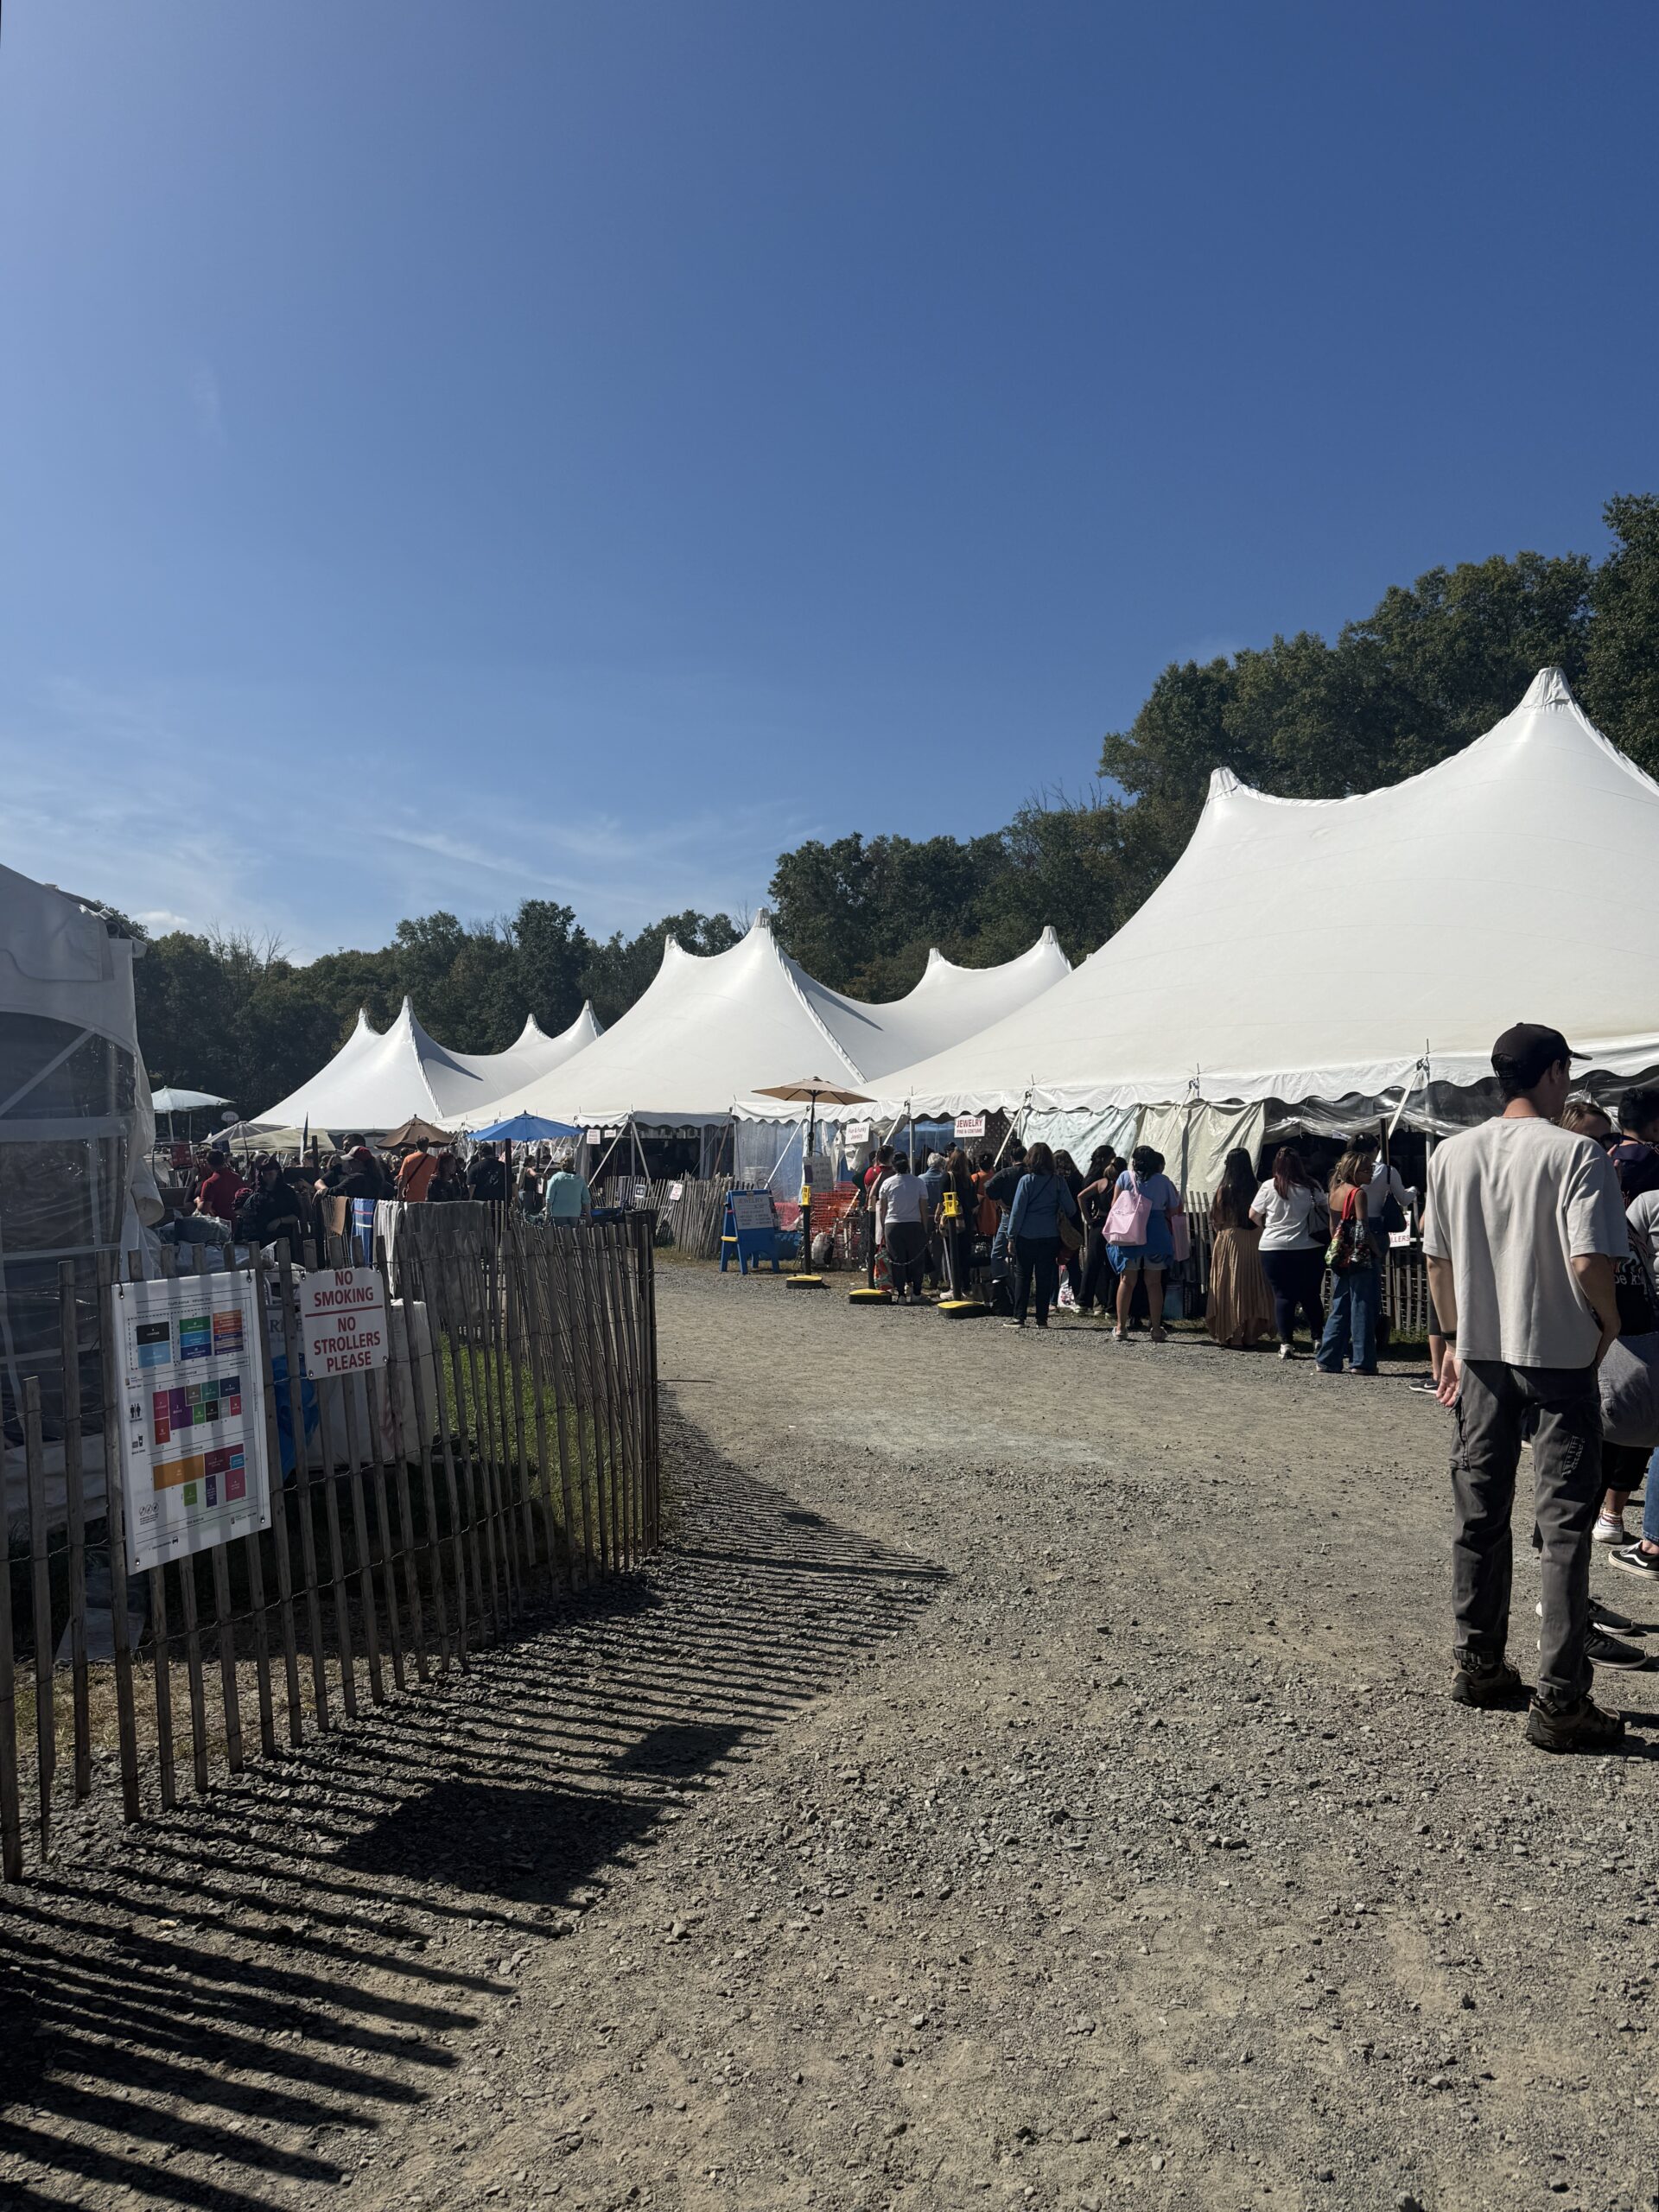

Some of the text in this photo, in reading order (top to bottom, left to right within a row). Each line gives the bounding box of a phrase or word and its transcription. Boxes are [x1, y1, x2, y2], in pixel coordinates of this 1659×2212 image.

[957, 1118, 982, 1128] JEWELRY
[334, 1270, 353, 1286] NO
[314, 1286, 374, 1308] SMOKING
[338, 1316, 356, 1332] NO
[314, 1332, 381, 1355] STROLLERS
[327, 1351, 372, 1373] PLEASE
